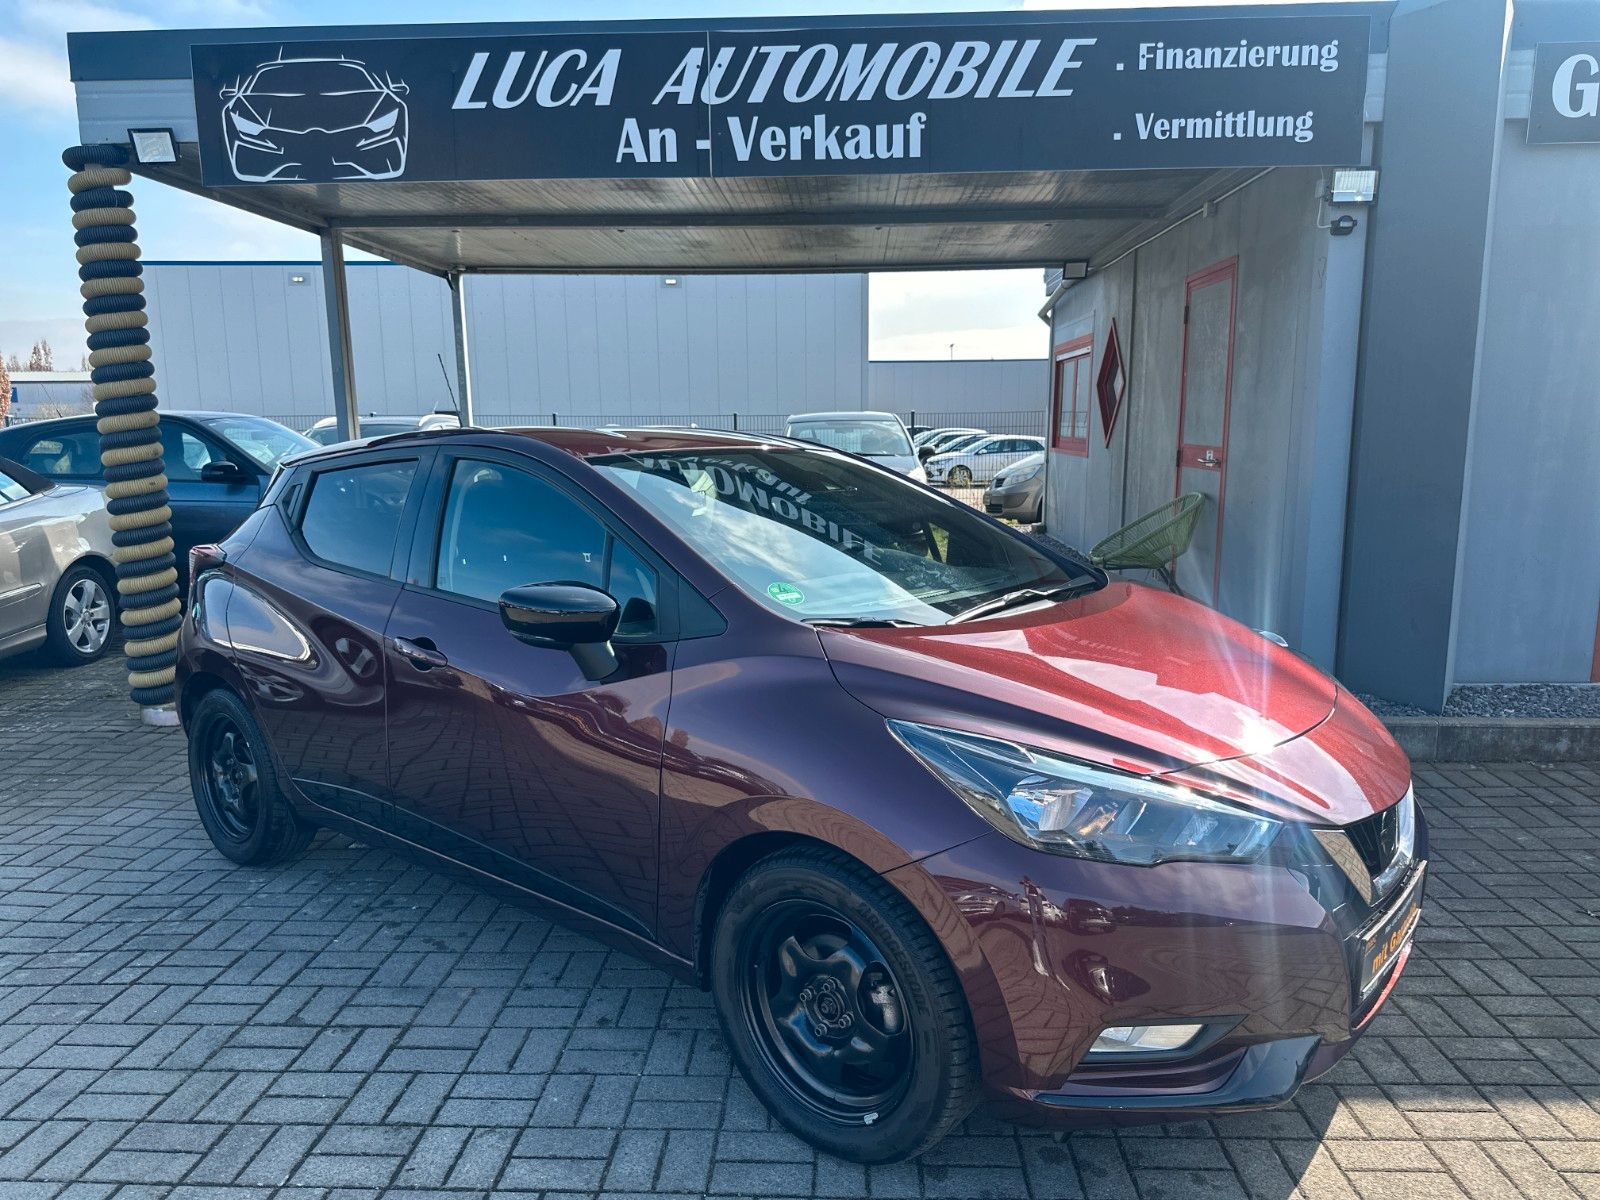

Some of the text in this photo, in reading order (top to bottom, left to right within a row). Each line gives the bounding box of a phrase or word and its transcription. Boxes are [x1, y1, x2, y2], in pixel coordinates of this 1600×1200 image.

[452, 38, 1097, 109] LUCA AUTOMOBILE
[1139, 40, 1338, 72] Finanzierung
[1552, 54, 1599, 117] G
[616, 118, 677, 162] An
[727, 112, 926, 161] Verkauf
[1136, 110, 1313, 142] Vermittlung
[857, 901, 928, 1014] BRIDGESTONE
